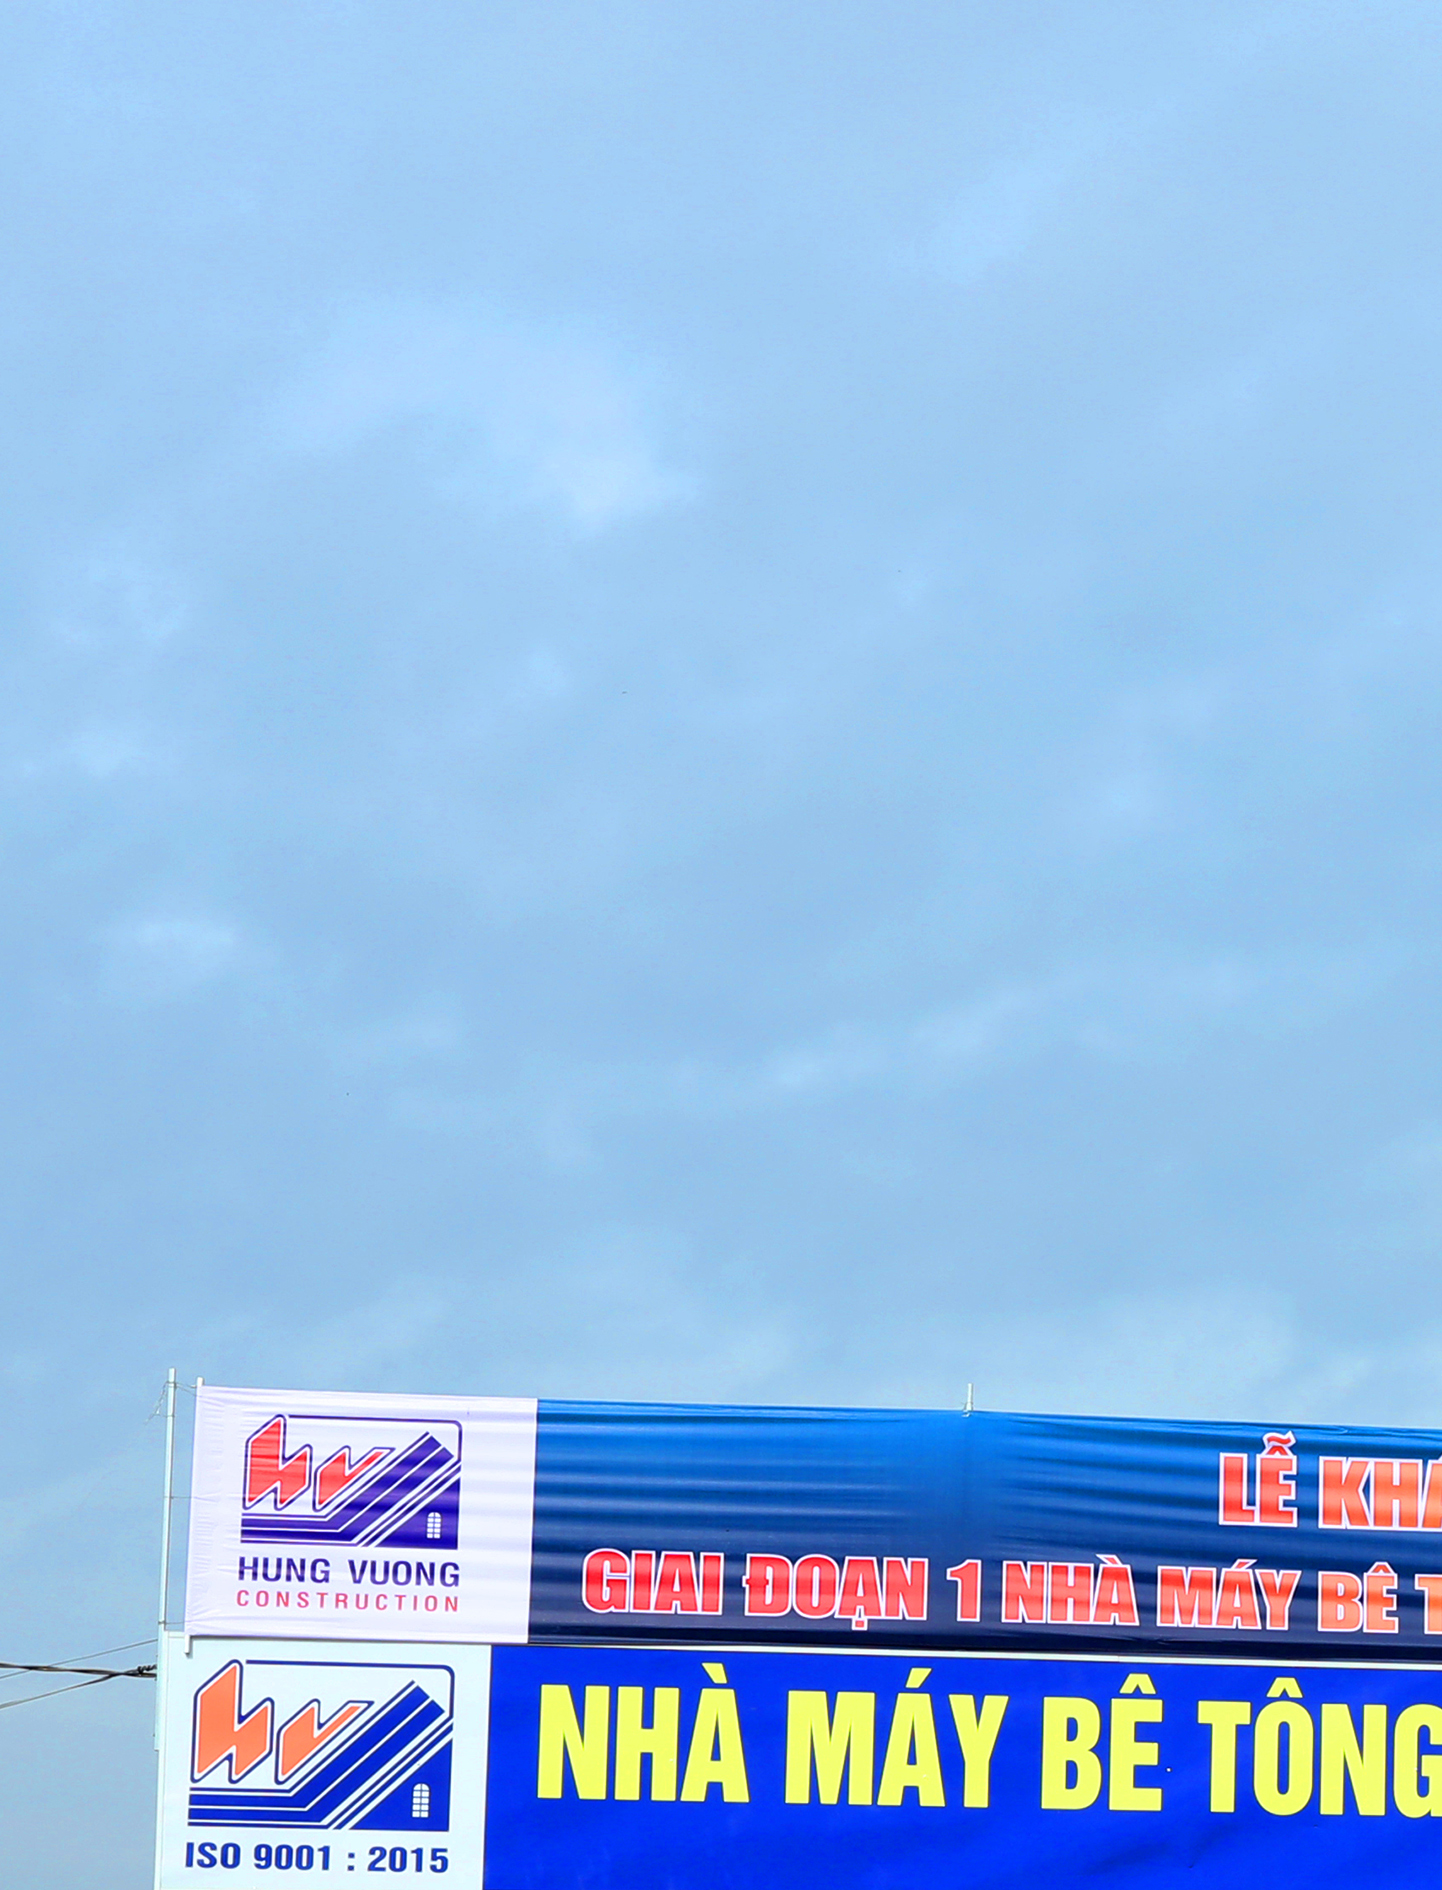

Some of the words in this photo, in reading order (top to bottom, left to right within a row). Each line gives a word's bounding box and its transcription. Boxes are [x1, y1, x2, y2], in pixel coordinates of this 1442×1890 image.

[1218, 1432, 1298, 1528] LỄ
[236, 1589, 460, 1613] CONSTRUCTION
[237, 1556, 331, 1585] HUNG
[348, 1559, 461, 1588] VUONG
[581, 1548, 724, 1616] GIAI
[742, 1553, 931, 1631] ĐOẠN
[946, 1558, 982, 1623] 1
[1001, 1554, 1140, 1626] NHÀ
[1157, 1559, 1302, 1632] MÁY
[1318, 1562, 1399, 1634] BÊ
[537, 1662, 749, 1803] NHÀ
[785, 1667, 1009, 1808] MÁY
[1041, 1674, 1163, 1812] BÊ
[185, 1842, 242, 1870] ISO
[254, 1844, 332, 1872] 9001
[367, 1846, 449, 1874] 2015
